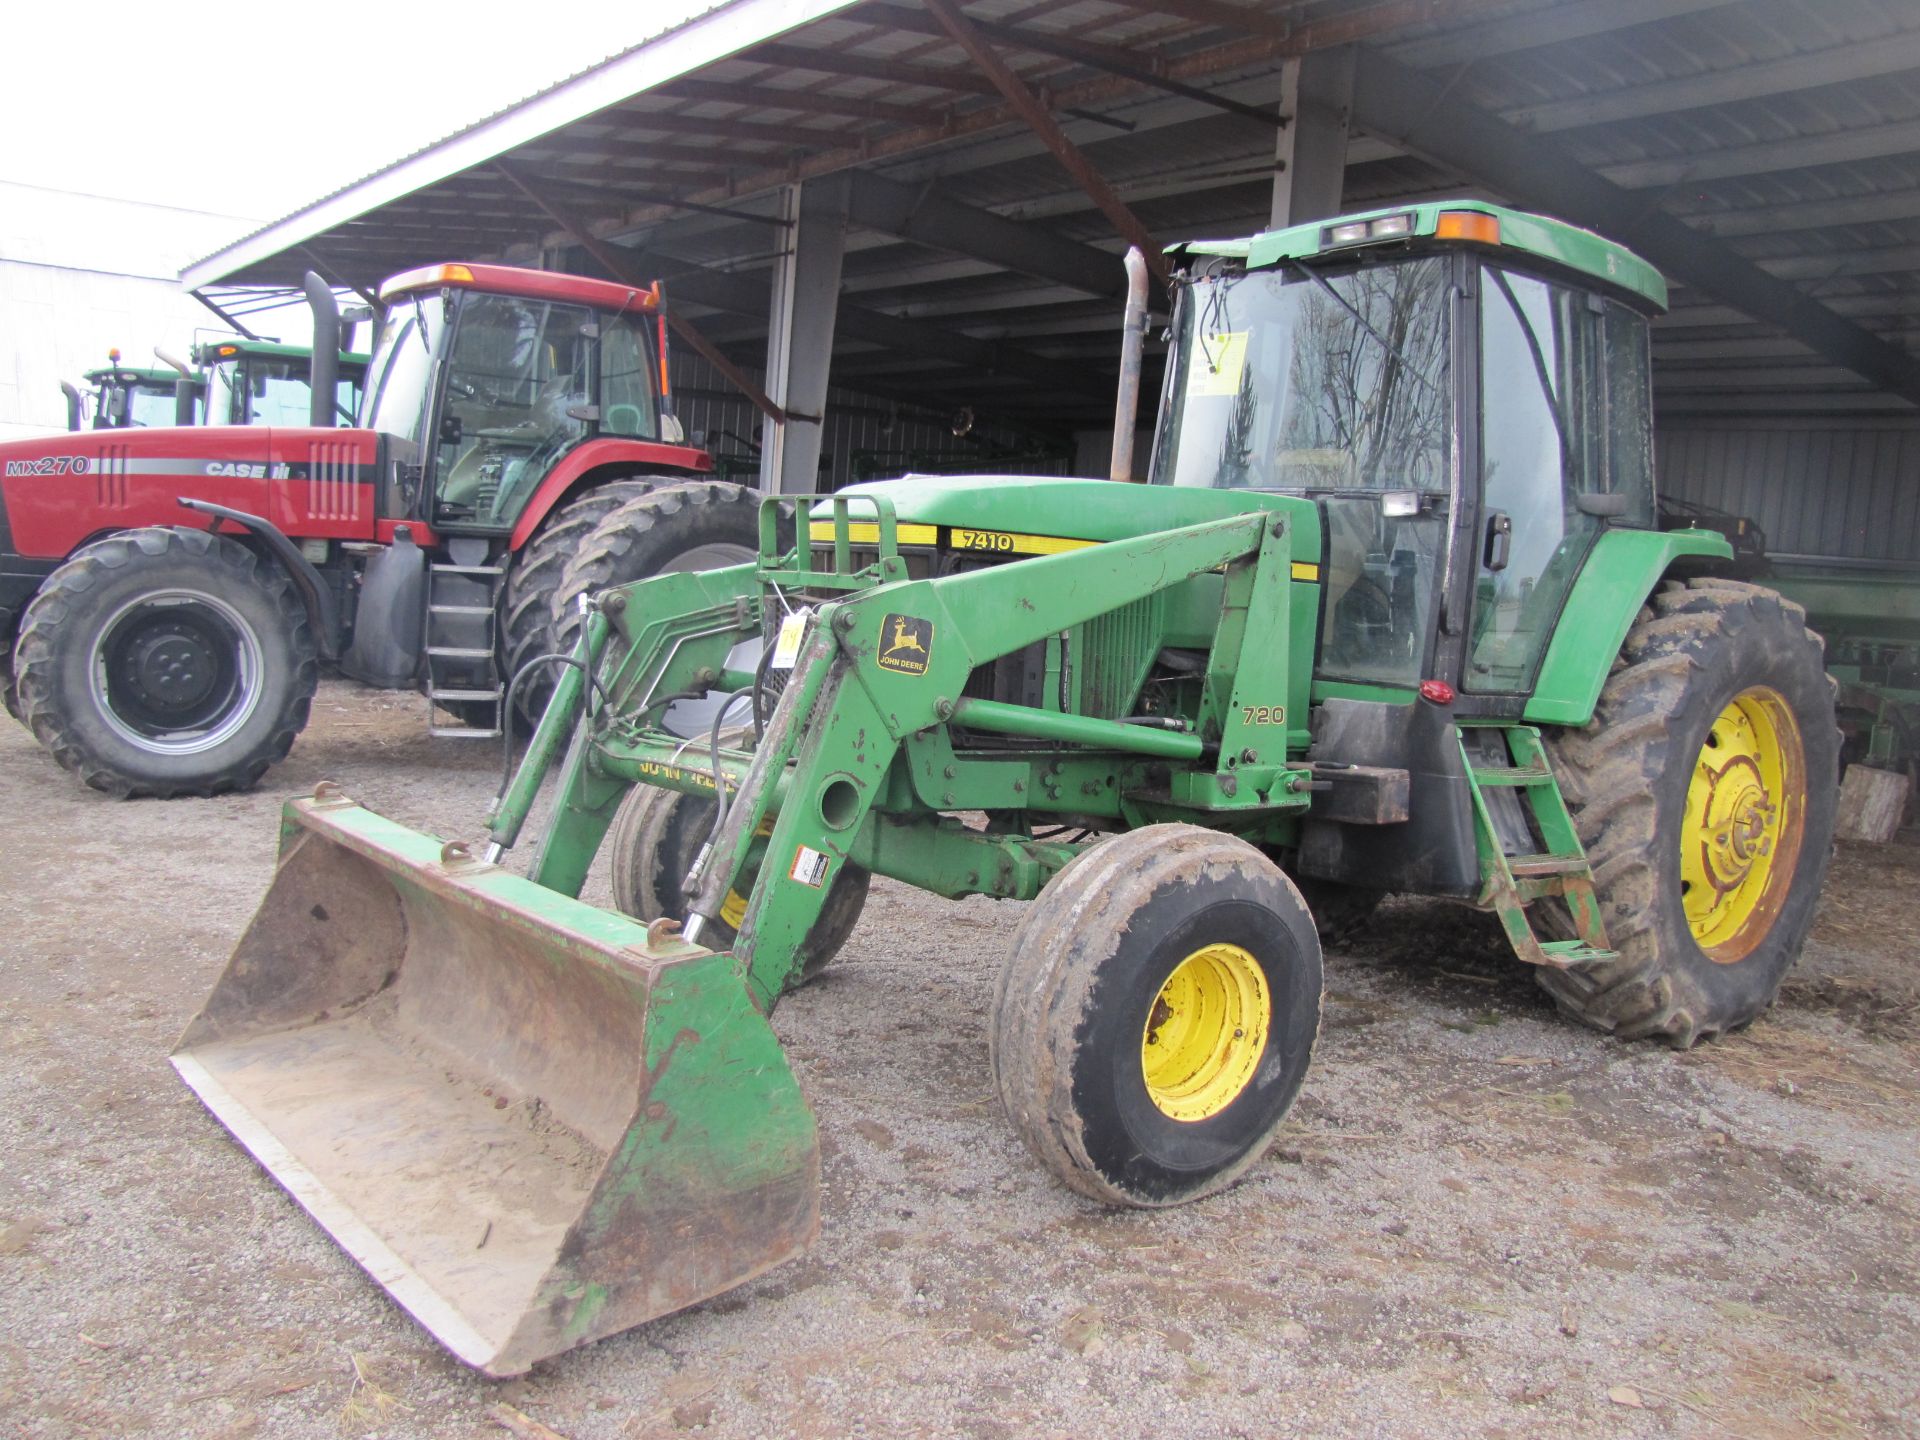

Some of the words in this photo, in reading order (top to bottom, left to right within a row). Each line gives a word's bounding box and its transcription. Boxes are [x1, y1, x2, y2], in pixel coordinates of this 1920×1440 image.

[5, 456, 91, 477] MX270
[205, 462, 267, 479] CASE
[962, 531, 1014, 551] 7410
[880, 655, 900, 667] JOHN
[900, 660, 924, 671] DEERE
[1242, 705, 1285, 725] 720
